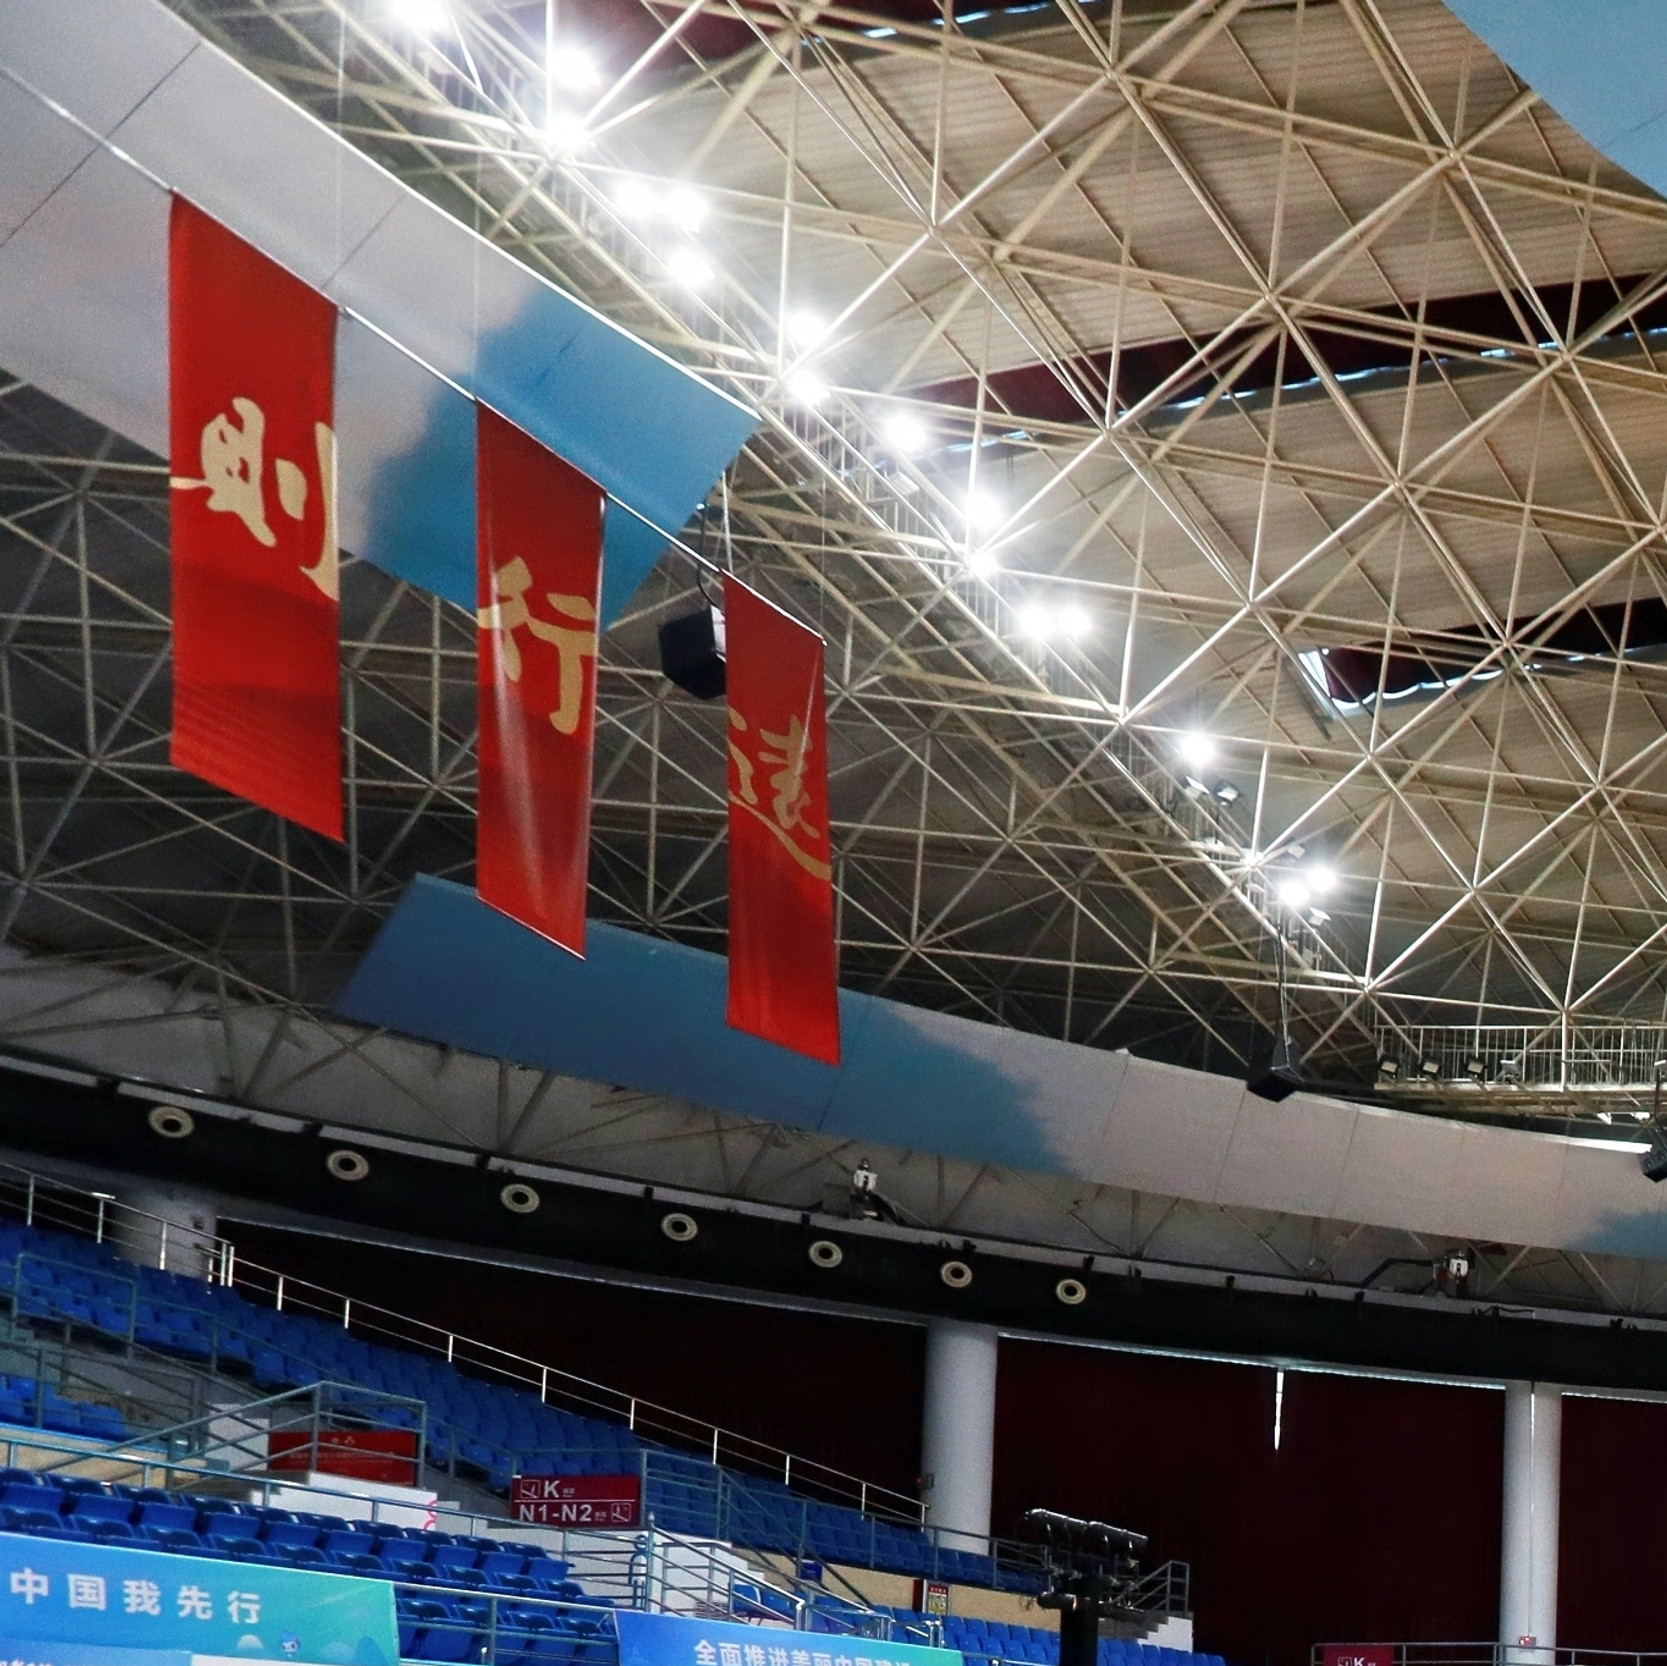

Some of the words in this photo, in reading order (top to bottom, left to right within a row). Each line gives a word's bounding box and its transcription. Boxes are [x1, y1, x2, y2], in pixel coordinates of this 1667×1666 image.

[479, 557, 599, 735] 行
[543, 1480, 560, 1498] K
[519, 1502, 593, 1522] N1-N2
[10, 1567, 262, 1624] 中国我先行
